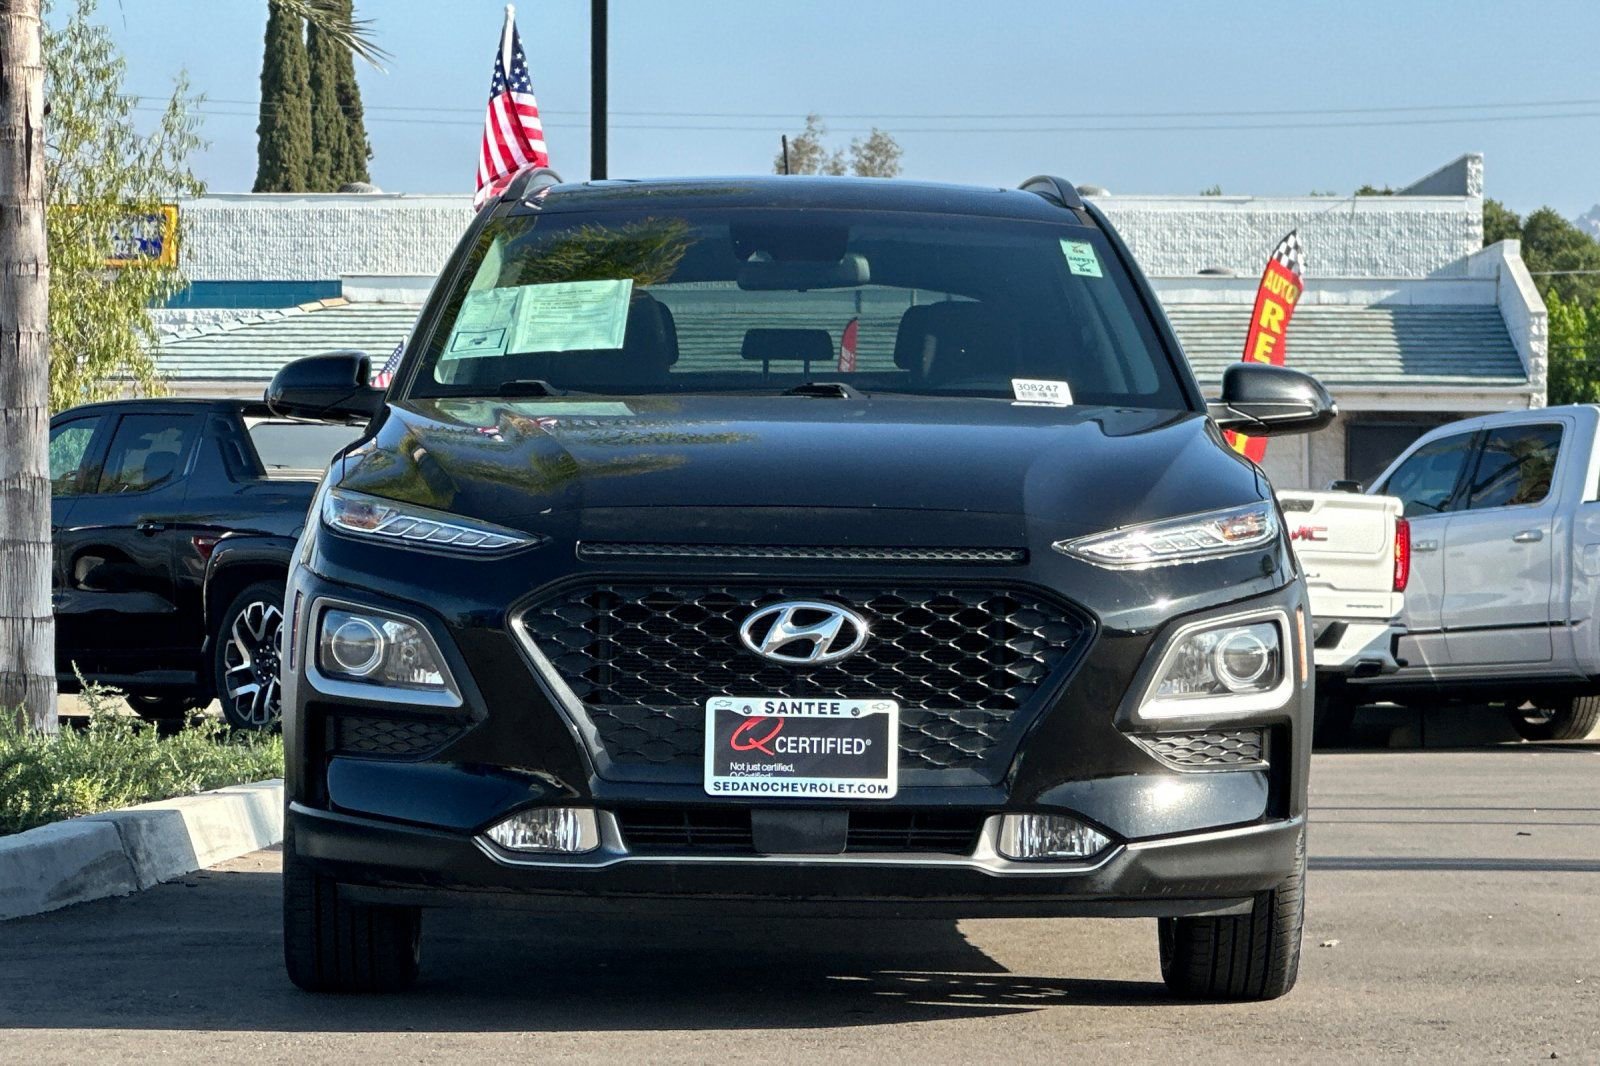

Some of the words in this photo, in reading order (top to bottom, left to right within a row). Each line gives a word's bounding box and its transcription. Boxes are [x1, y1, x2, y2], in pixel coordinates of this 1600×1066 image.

[1264, 269, 1299, 305] AUTO
[1016, 383, 1059, 393] 308247
[764, 700, 841, 715] SANTEE
[729, 762, 745, 771] Not
[745, 762, 761, 772] just
[713, 781, 889, 794] SEDANOCHEVROLET.COM
